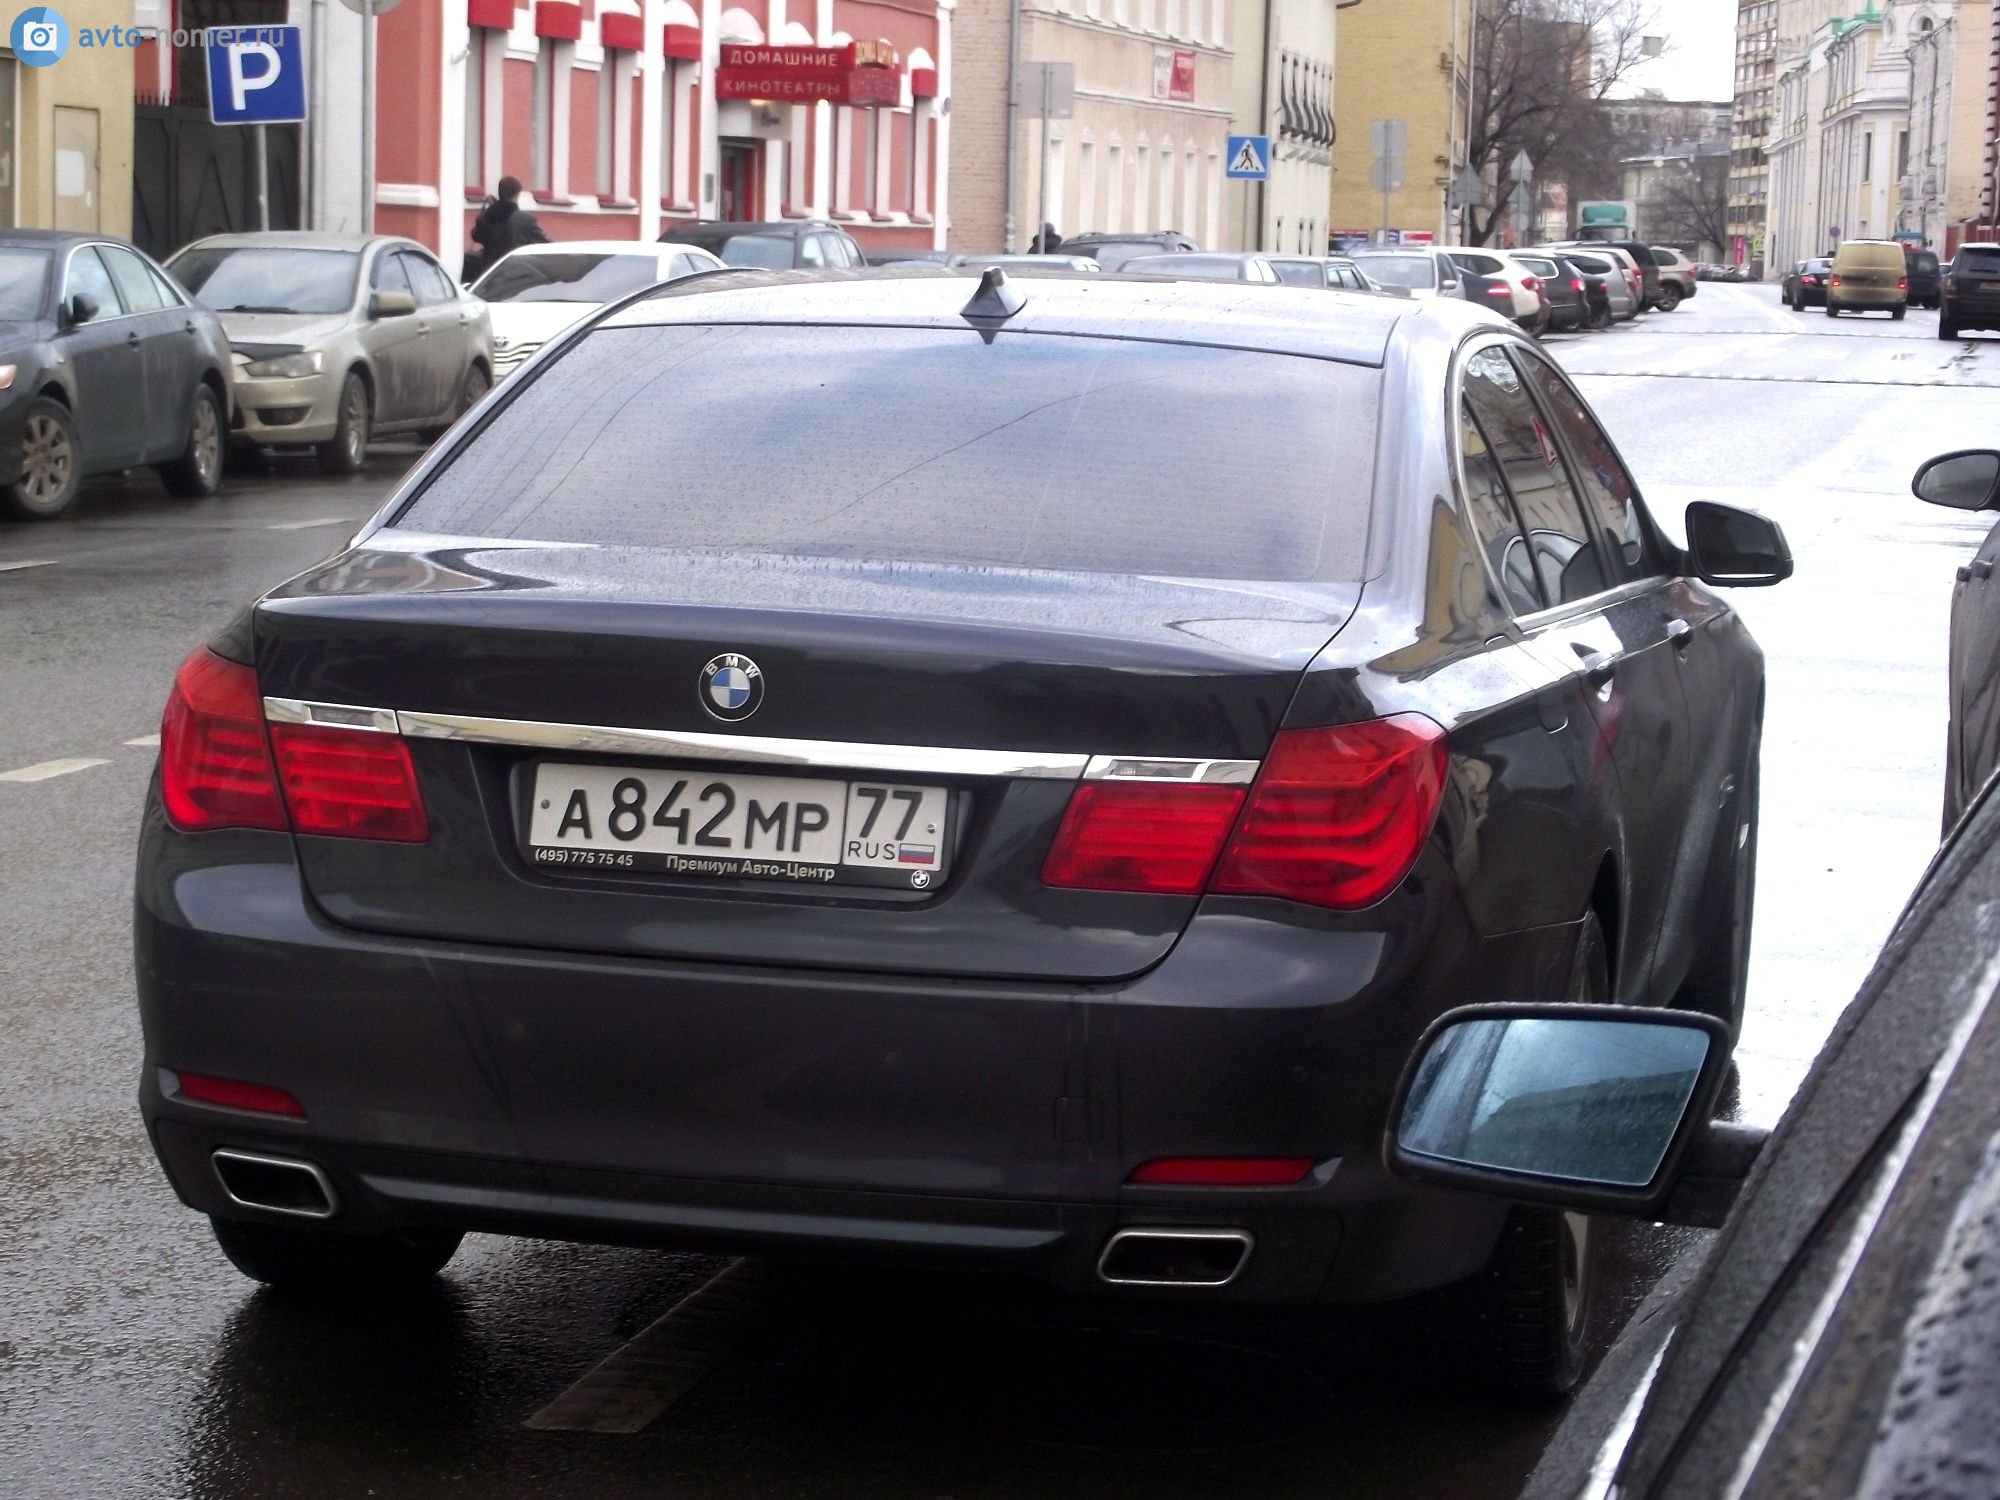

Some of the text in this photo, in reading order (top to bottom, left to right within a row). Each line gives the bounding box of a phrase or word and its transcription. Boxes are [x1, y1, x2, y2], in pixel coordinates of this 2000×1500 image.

[730, 50, 838, 67] ДОМАШНИЕ
[229, 41, 281, 110] P
[723, 80, 840, 95] КИНОТЕАТРЫ
[705, 655, 759, 679] BMW
[857, 787, 923, 841] 77
[535, 848, 634, 866] (495) 775 75 45
[848, 841, 895, 861] RUS
[666, 855, 836, 882] Премиум Авто-Центр
